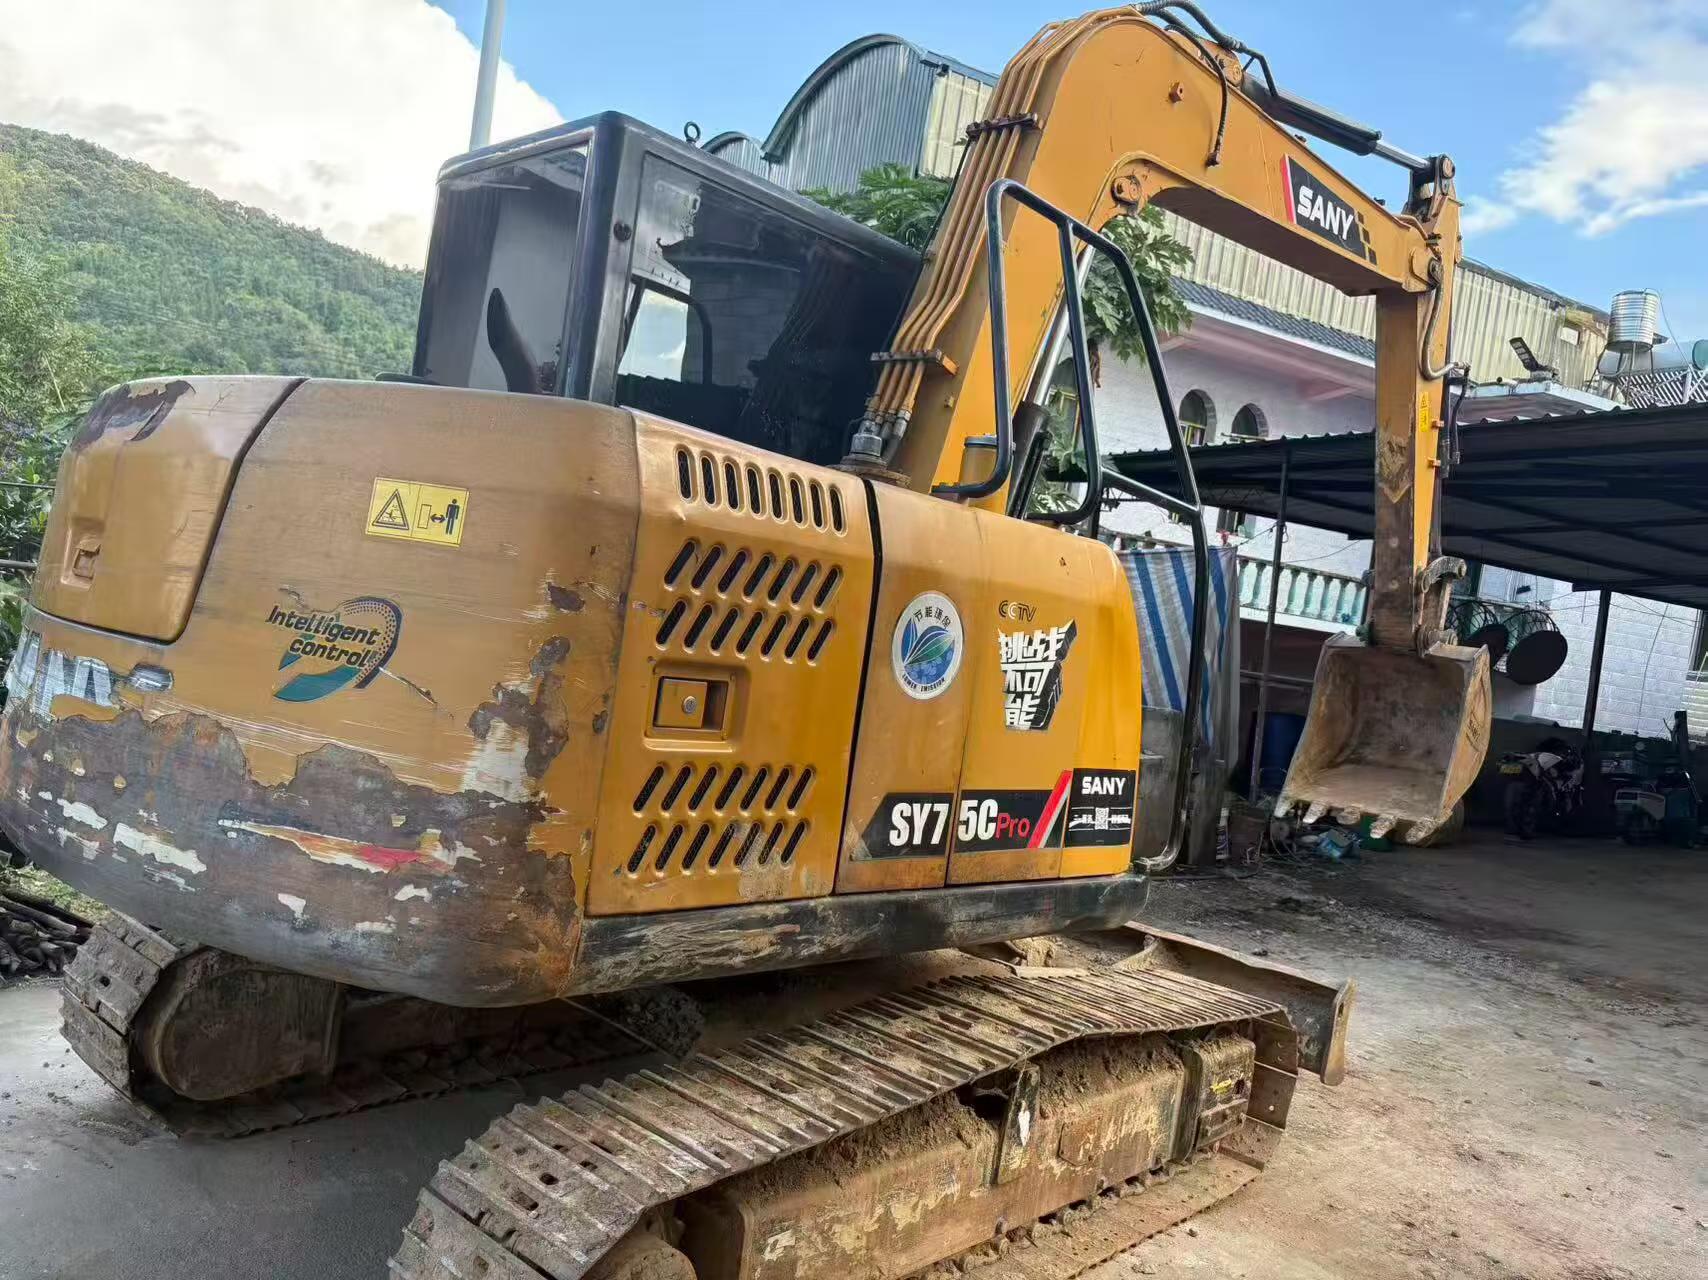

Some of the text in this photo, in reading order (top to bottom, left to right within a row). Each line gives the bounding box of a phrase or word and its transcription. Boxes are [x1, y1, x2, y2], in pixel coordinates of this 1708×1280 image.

[1297, 185, 1354, 240] SANY
[265, 605, 381, 646] Intelligent
[998, 600, 1038, 622] CCTV
[289, 638, 372, 668] control
[1081, 776, 1127, 796] SANY
